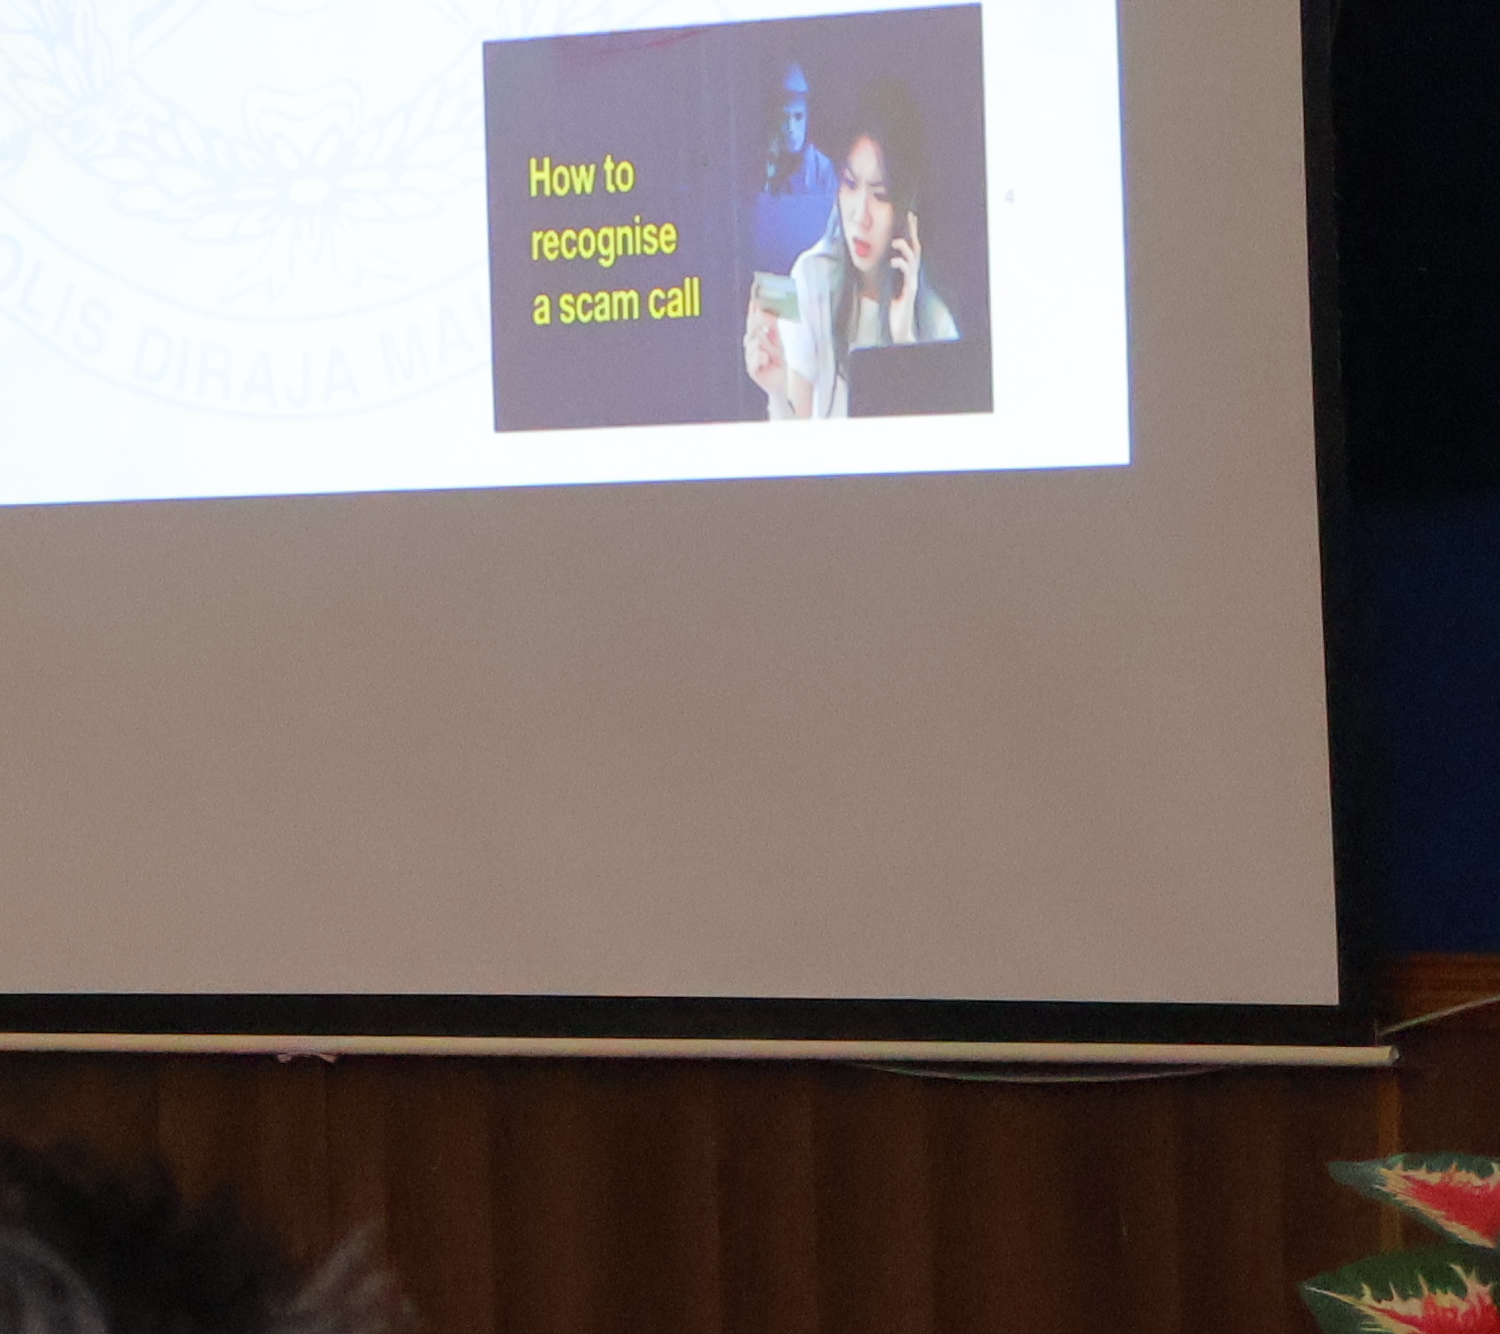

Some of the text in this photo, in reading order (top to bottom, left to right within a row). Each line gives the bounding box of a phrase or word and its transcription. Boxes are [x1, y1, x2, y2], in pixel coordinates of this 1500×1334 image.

[528, 153, 635, 198] How to
[531, 214, 678, 269] recognise
[532, 276, 701, 326] a scam call
[131, 322, 362, 409] DIRAJA
